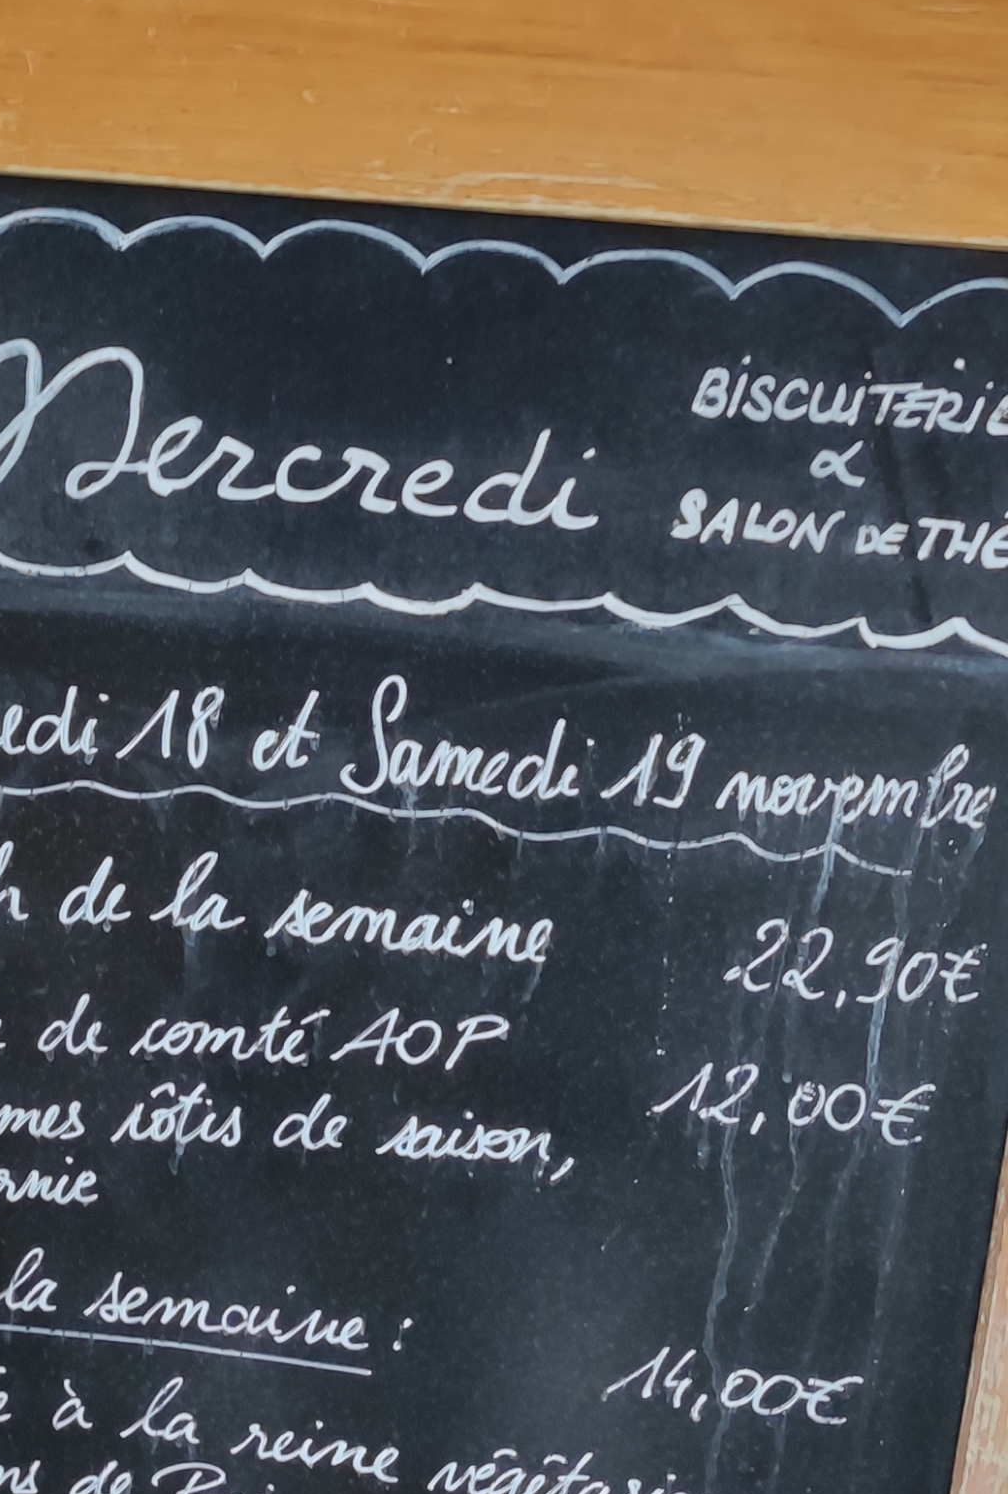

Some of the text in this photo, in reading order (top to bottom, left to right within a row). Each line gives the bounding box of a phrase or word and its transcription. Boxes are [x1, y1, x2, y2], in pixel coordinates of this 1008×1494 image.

[669, 488, 845, 555] SALON
[116, 685, 225, 769] 18
[252, 689, 320, 771] et
[339, 674, 594, 795] Samedi
[600, 733, 706, 808] 19
[715, 743, 996, 829] novembre
[58, 855, 132, 929] de
[149, 851, 246, 931] la
[264, 889, 555, 965] semaine
[723, 918, 988, 1007] 22,90€
[37, 993, 108, 1053] de
[129, 1005, 331, 1065] comté
[330, 1006, 510, 1070] AOP
[272, 1093, 350, 1150] de
[375, 1110, 575, 1182] saison,
[646, 1062, 938, 1145] 12,00€
[82, 1271, 371, 1350] semaine
[601, 1346, 864, 1424] 14,00€
[52, 1379, 93, 1431] à
[120, 1376, 200, 1445] la
[230, 1419, 400, 1484] reine
